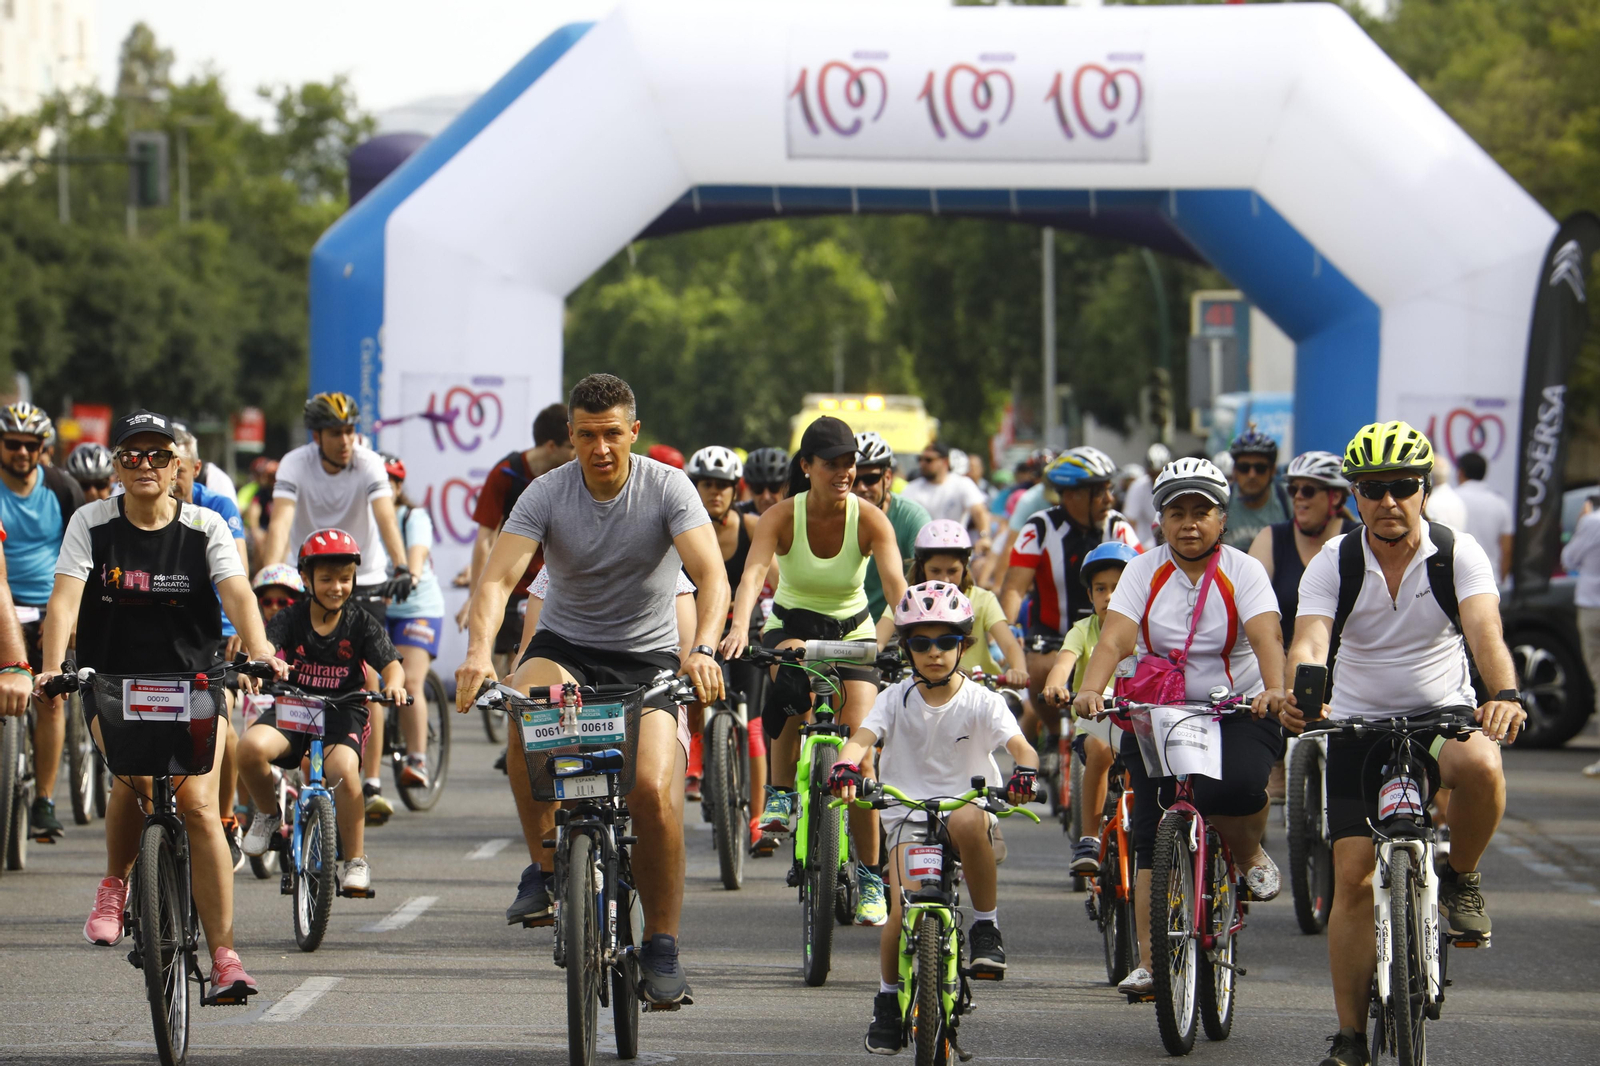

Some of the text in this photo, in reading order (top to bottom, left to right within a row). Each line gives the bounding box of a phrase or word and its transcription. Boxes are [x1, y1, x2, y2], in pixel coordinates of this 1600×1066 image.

[293, 658, 349, 678] Emirates
[297, 673, 340, 689] FLY BETTER
[146, 695, 170, 703] 00070
[581, 721, 614, 732] 00618
[1389, 792, 1411, 801] 0050
[923, 857, 942, 866] 0057
